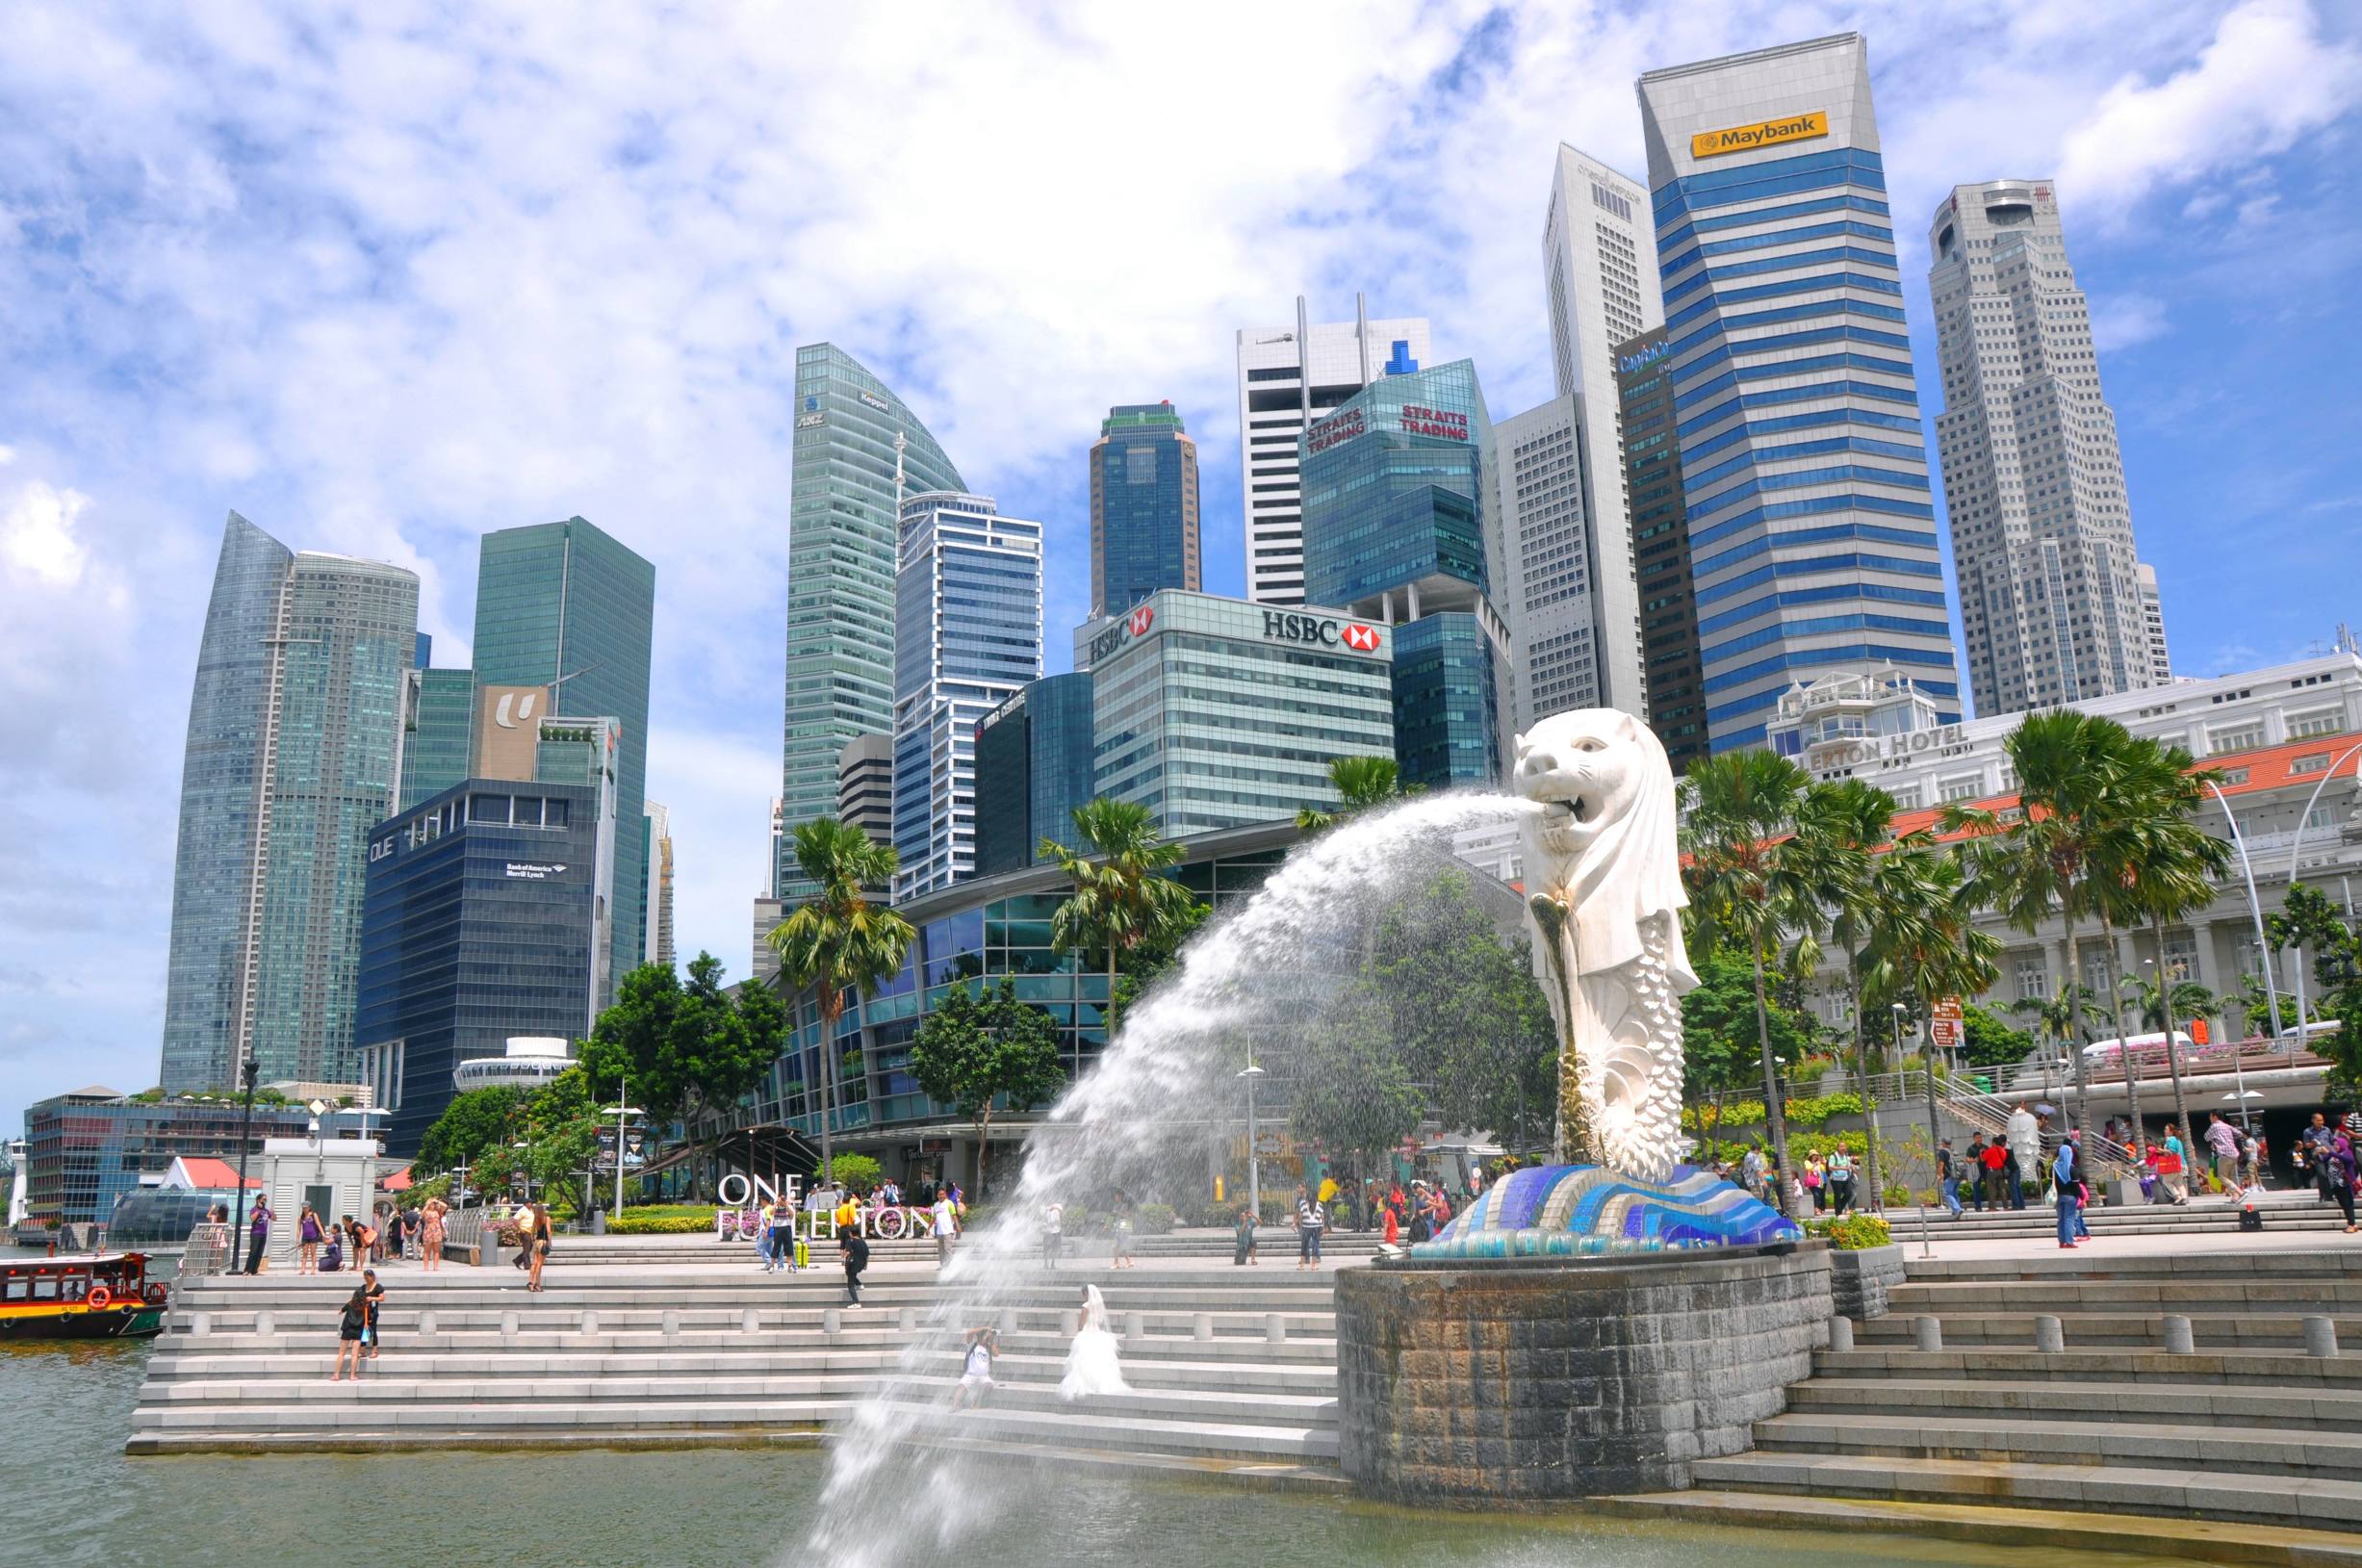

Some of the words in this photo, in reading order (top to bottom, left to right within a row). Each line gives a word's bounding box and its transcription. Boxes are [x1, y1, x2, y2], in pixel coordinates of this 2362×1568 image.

[1721, 117, 1815, 146] Maybank
[860, 391, 888, 411] Keppel
[1402, 405, 1468, 426] STRAITS
[797, 413, 825, 428] ANZ
[1307, 408, 1361, 441] STRAITS
[1400, 419, 1469, 441] TRADING
[1308, 422, 1365, 454] TRADING
[1090, 617, 1130, 664] HSBC
[1262, 611, 1339, 646] HSBC
[1891, 724, 1969, 756] HOTEL
[371, 835, 394, 862] OUE
[718, 1173, 803, 1206] ONE
[718, 1207, 935, 1240] FULETON
